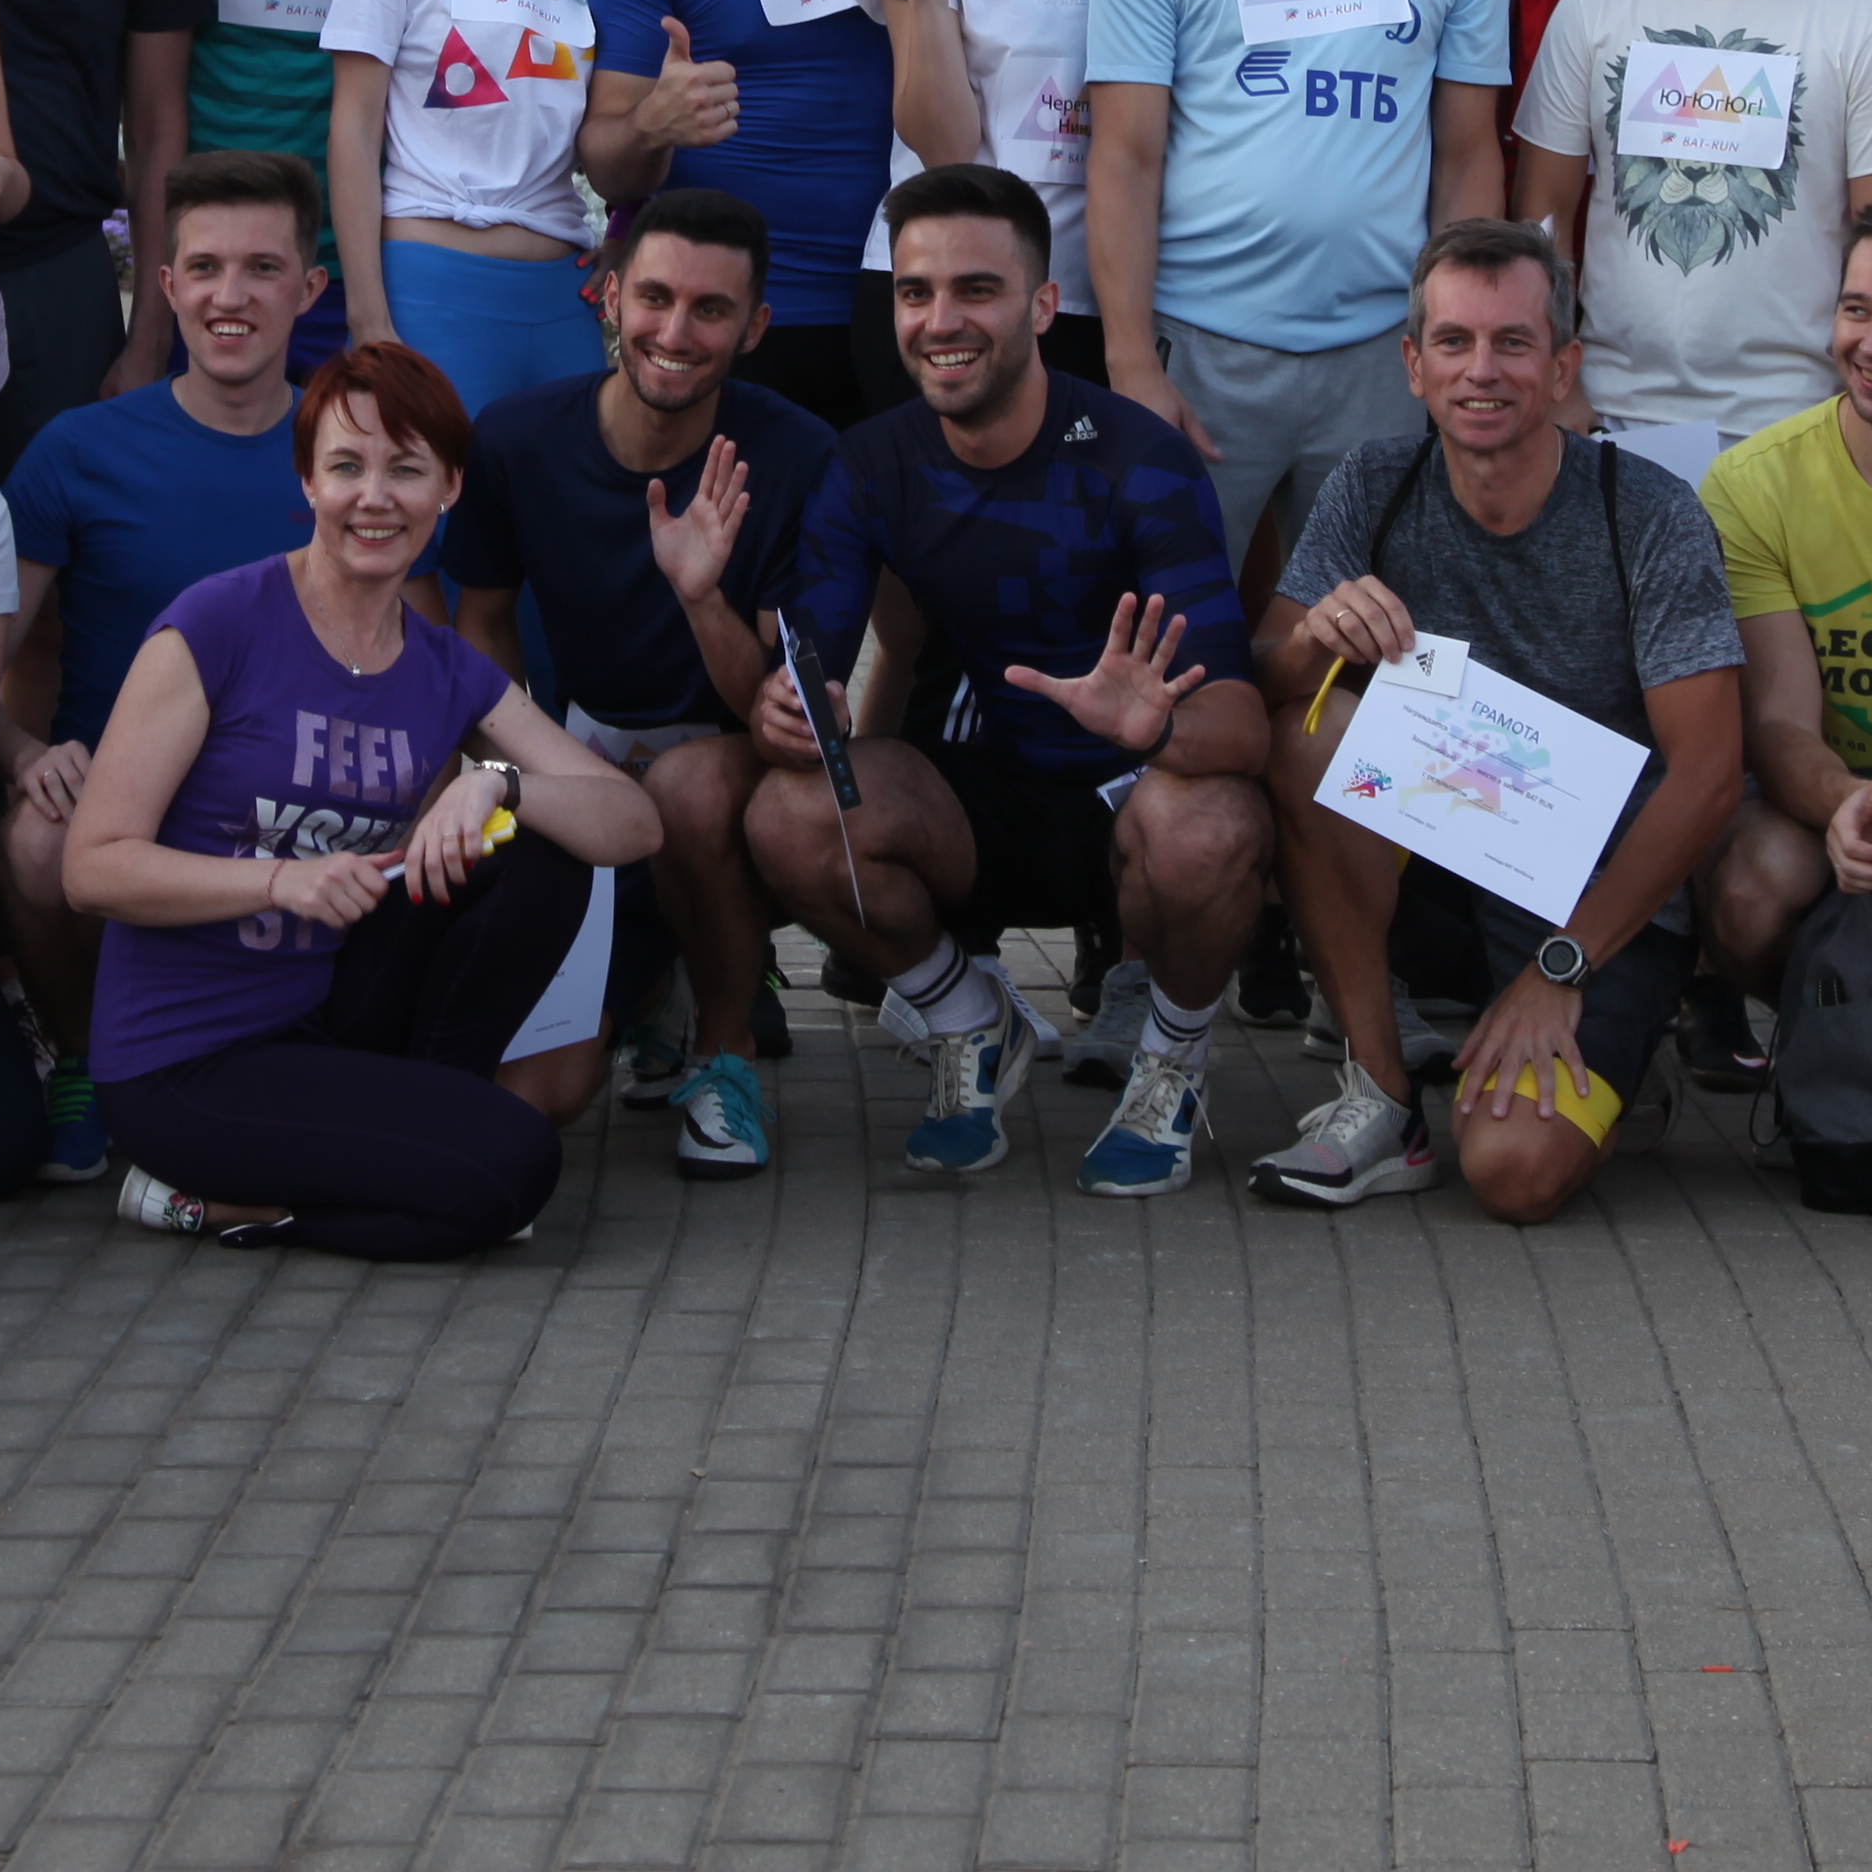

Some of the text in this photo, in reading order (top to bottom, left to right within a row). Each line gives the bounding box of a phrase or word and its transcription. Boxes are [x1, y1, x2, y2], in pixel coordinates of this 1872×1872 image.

[1306, 1, 1363, 19] BAT-RUN
[1305, 68, 1399, 123] ВТБ
[1659, 88, 1763, 116] ЮгЮгЮг!
[1682, 136, 1740, 153] BAT-RUN
[1471, 700, 1541, 745] ГРАМОТА
